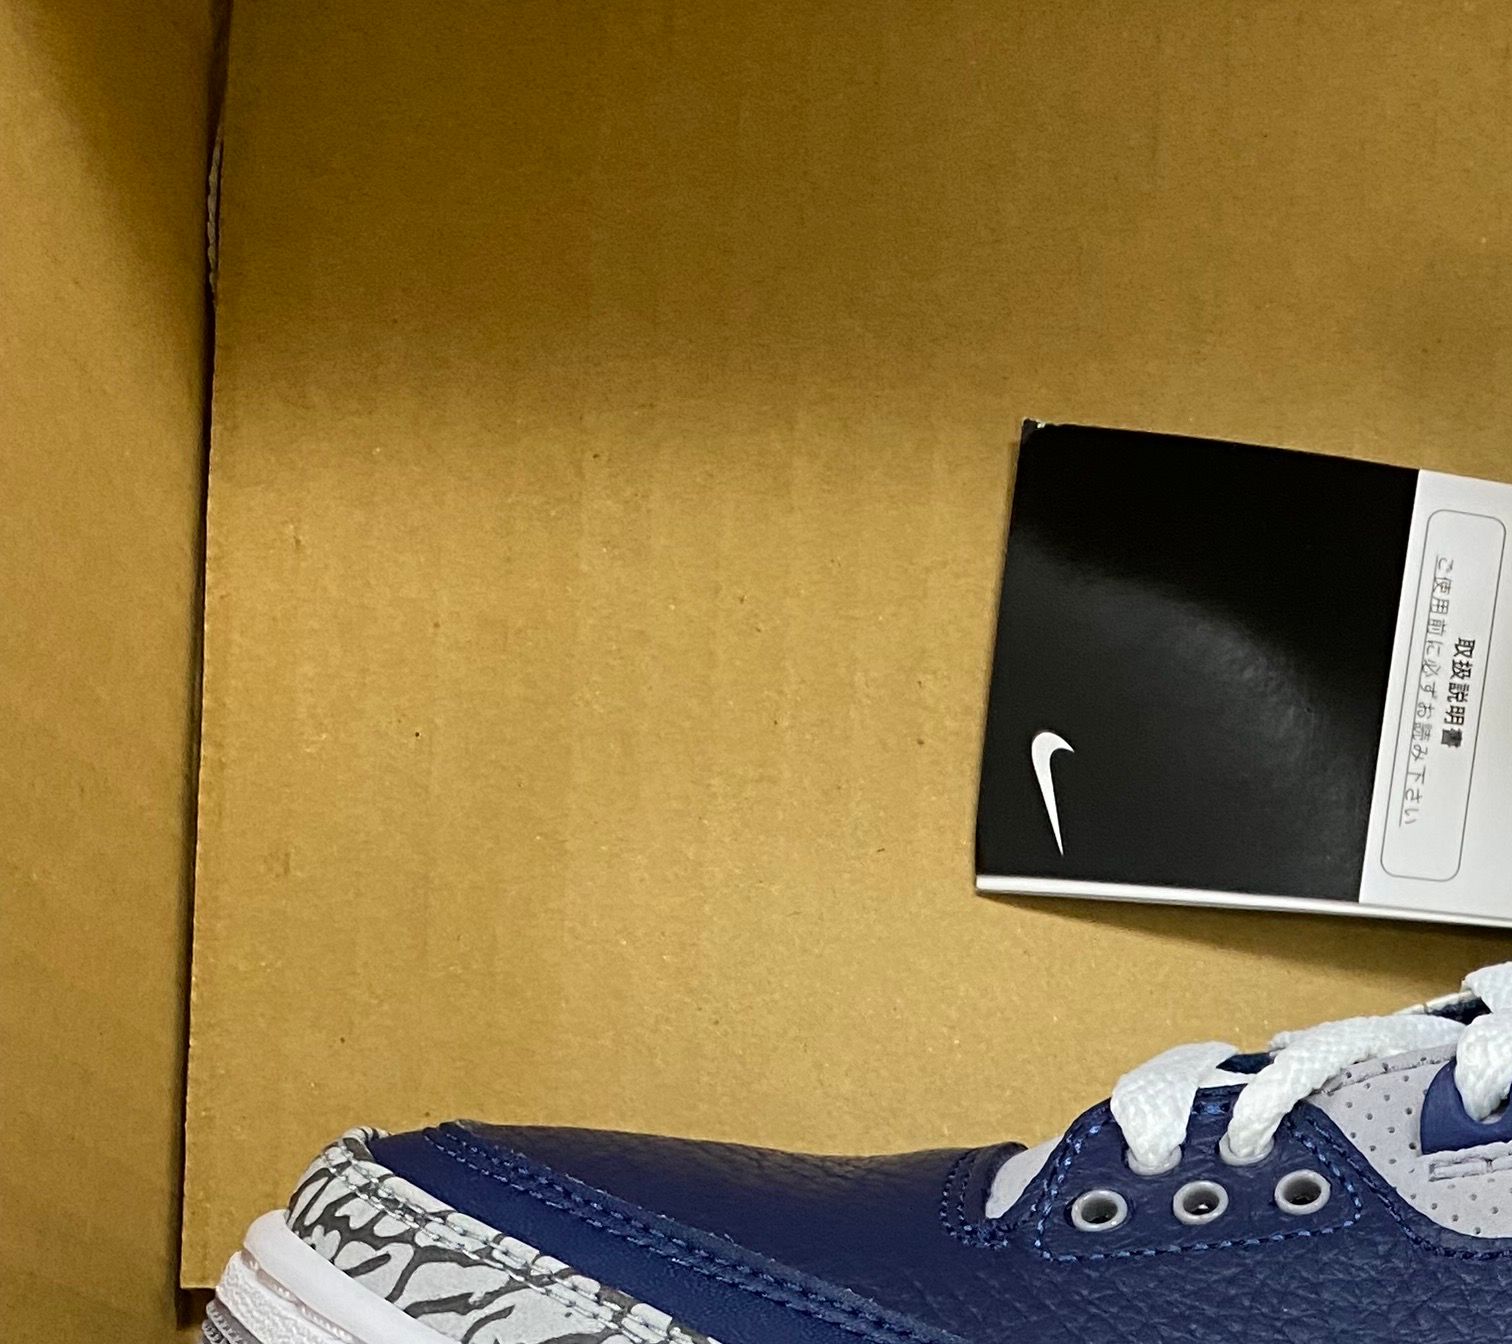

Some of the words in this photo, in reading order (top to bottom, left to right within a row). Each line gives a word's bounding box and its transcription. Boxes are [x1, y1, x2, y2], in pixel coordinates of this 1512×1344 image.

[1403, 557, 1454, 824] ご使用前に必ずお読み下さい
[1440, 637, 1476, 748] 取扱説明書
